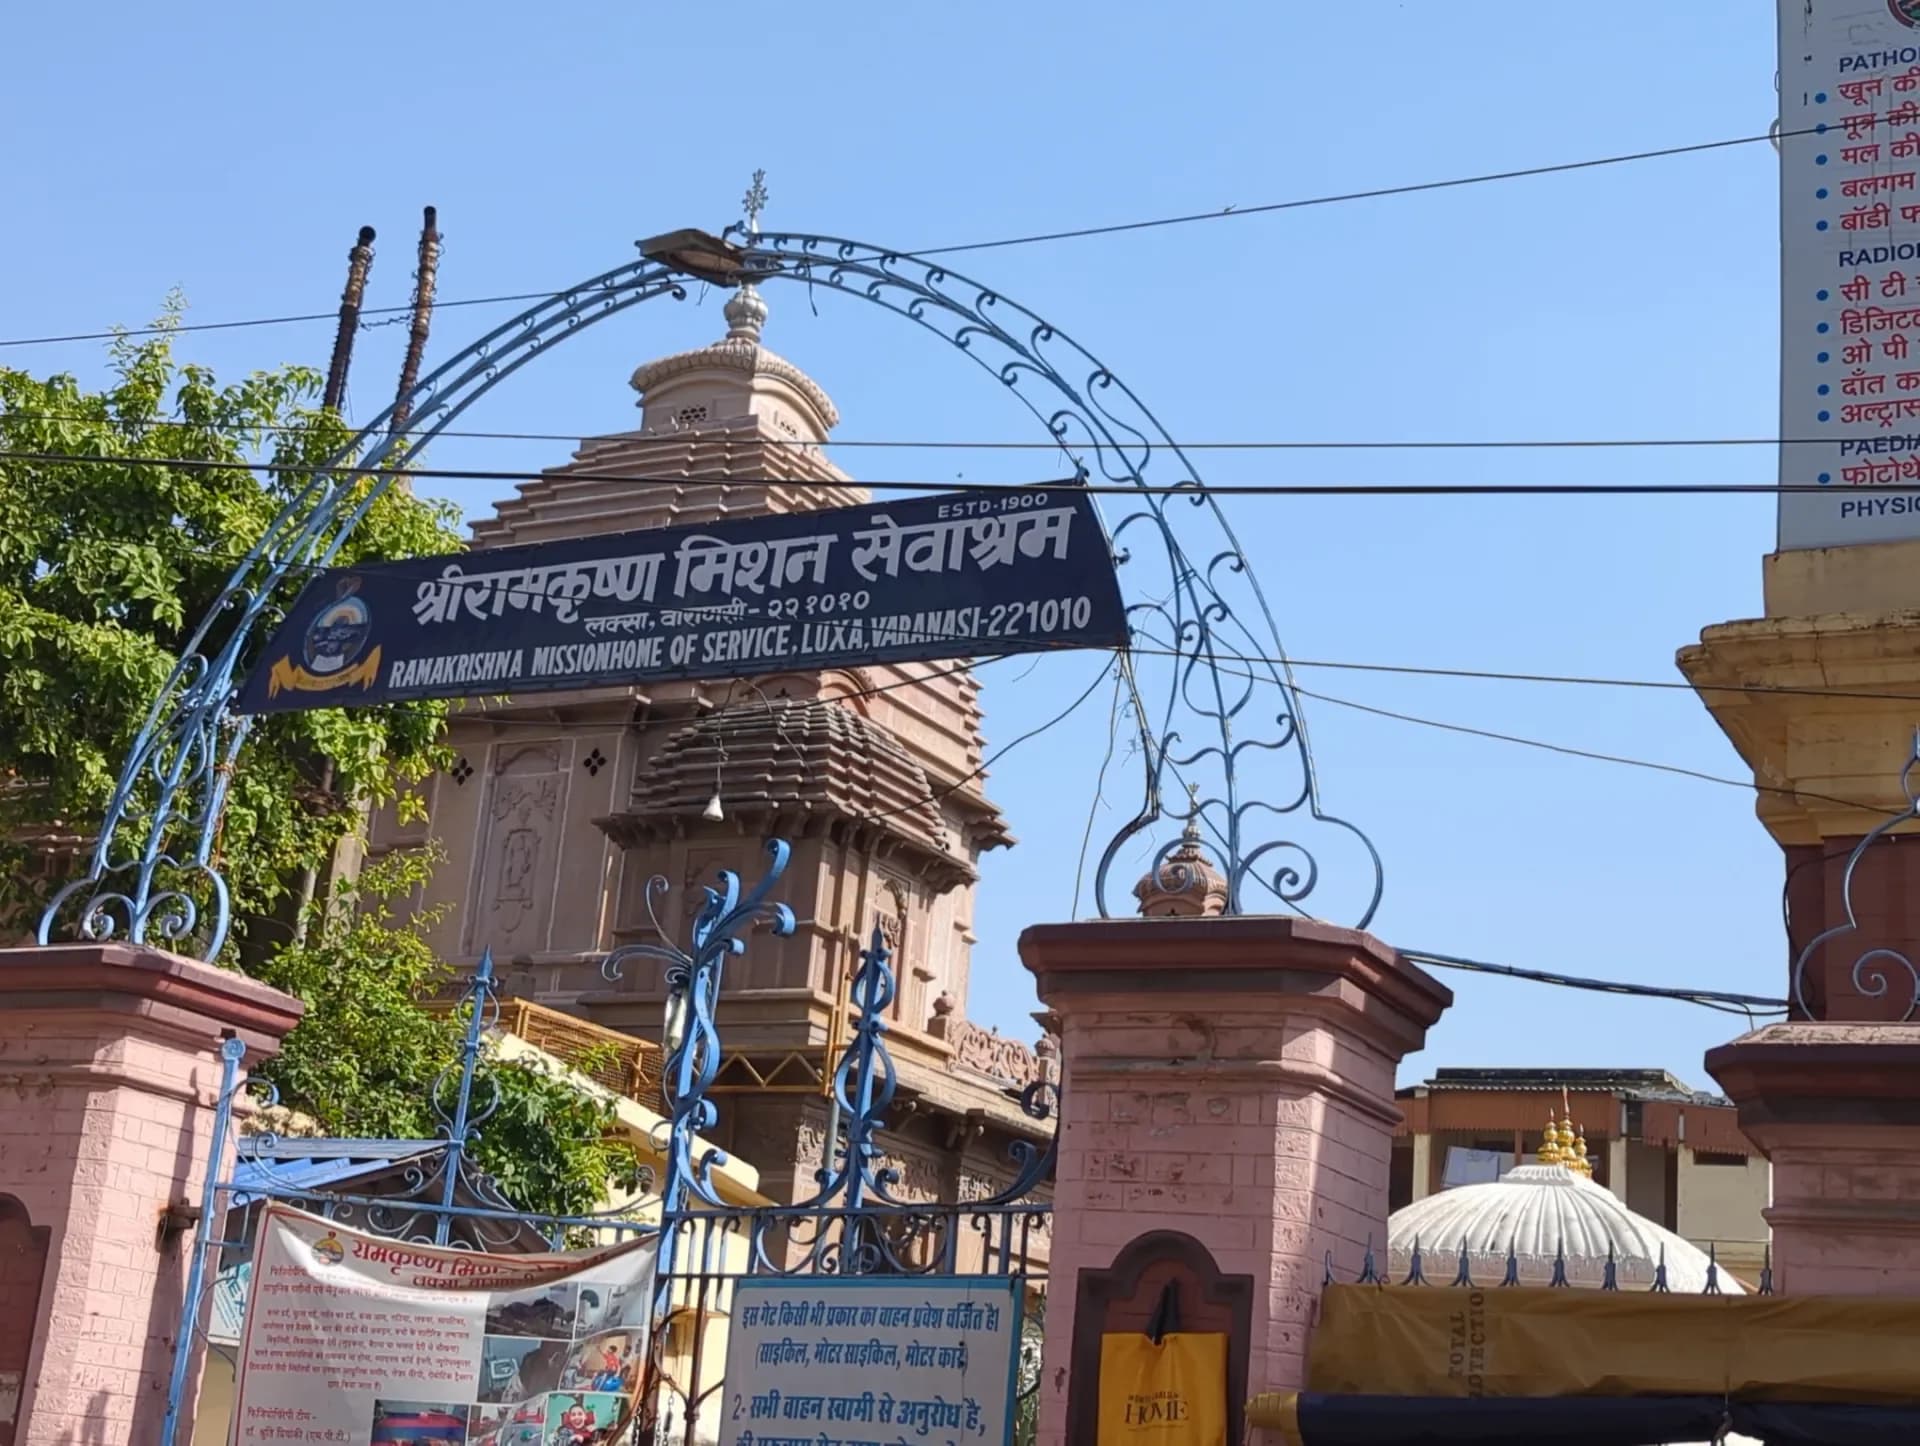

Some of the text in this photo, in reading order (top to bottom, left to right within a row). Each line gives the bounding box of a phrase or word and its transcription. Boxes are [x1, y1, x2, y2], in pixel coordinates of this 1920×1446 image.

[1839, 47, 1920, 73] PATHO
[1838, 79, 1883, 106] खून
[1840, 101, 1919, 140] मूत्र की
[1840, 132, 1920, 164] मल की
[1840, 172, 1916, 197] बलगम
[1840, 202, 1890, 231] बॉडी
[1839, 243, 1920, 267] RADIO
[1839, 275, 1871, 301] सी
[1880, 271, 1906, 297] टी
[1842, 334, 1908, 364] ओ पी
[412, 506, 1077, 625] श्रीरामकृष्ण मिशन सेवाश्रम
[584, 612, 656, 637] लक्सा,
[388, 650, 523, 688] RAMAKRISHNA
[669, 633, 699, 665] OF
[743, 1306, 759, 1329] इस
[761, 1301, 778, 1327] गेट
[779, 1301, 809, 1327] किसी
[811, 1301, 826, 1326] भी
[827, 1306, 859, 1327] प्रकार
[860, 1306, 877, 1327] का
[879, 1307, 912, 1328] वाहन
[913, 1302, 945, 1329] प्रवेश
[755, 1337, 810, 1370] (साइकिल,
[815, 1337, 844, 1364] मोटर
[845, 1338, 900, 1371] साइकिल,
[905, 1339, 937, 1367] मोटर
[1448, 1311, 1465, 1378] TOTAL
[750, 1389, 781, 1419] सभी
[783, 1396, 825, 1420] वाहन
[827, 1391, 875, 1423] स्वामी
[878, 1392, 896, 1424] से
[896, 1395, 963, 1435] अनुरोध
